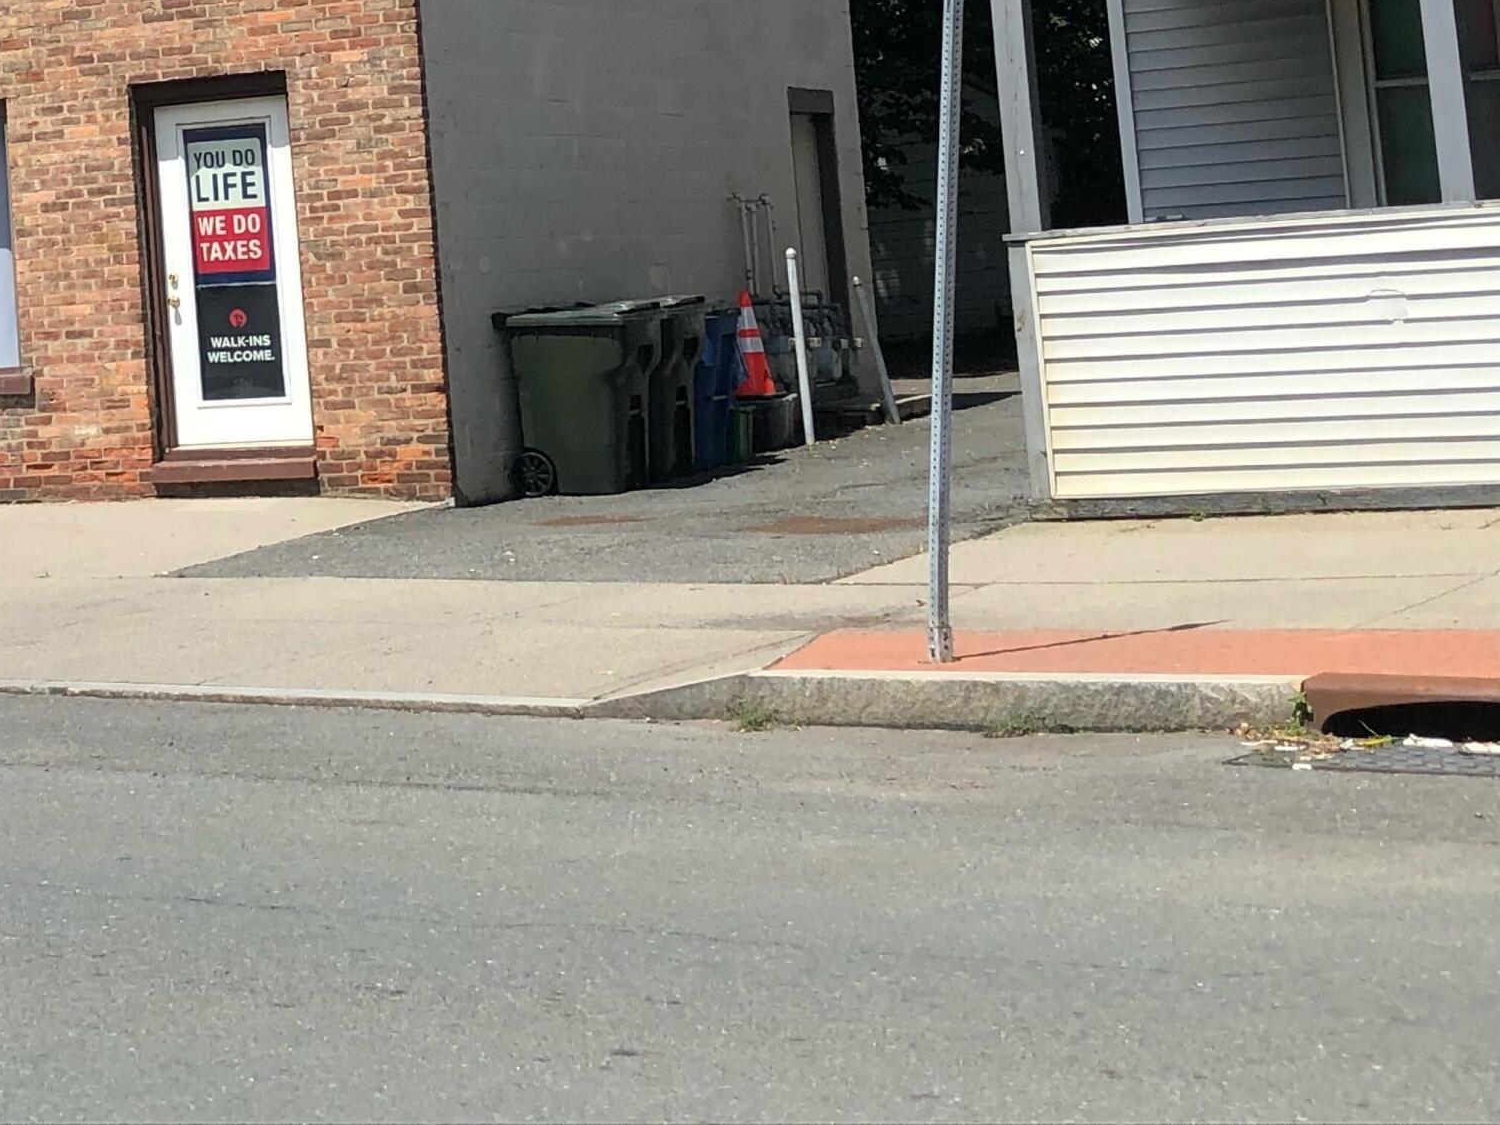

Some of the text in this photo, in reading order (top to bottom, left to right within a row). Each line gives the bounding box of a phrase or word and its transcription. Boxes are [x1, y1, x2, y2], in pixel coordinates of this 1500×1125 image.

[193, 148, 255, 169] YOU DO
[195, 171, 258, 203] LIFE
[198, 213, 261, 236] WE DO
[200, 239, 263, 262] TAXES
[210, 335, 271, 348] WALK-INS
[207, 349, 275, 363] WELCOME.
